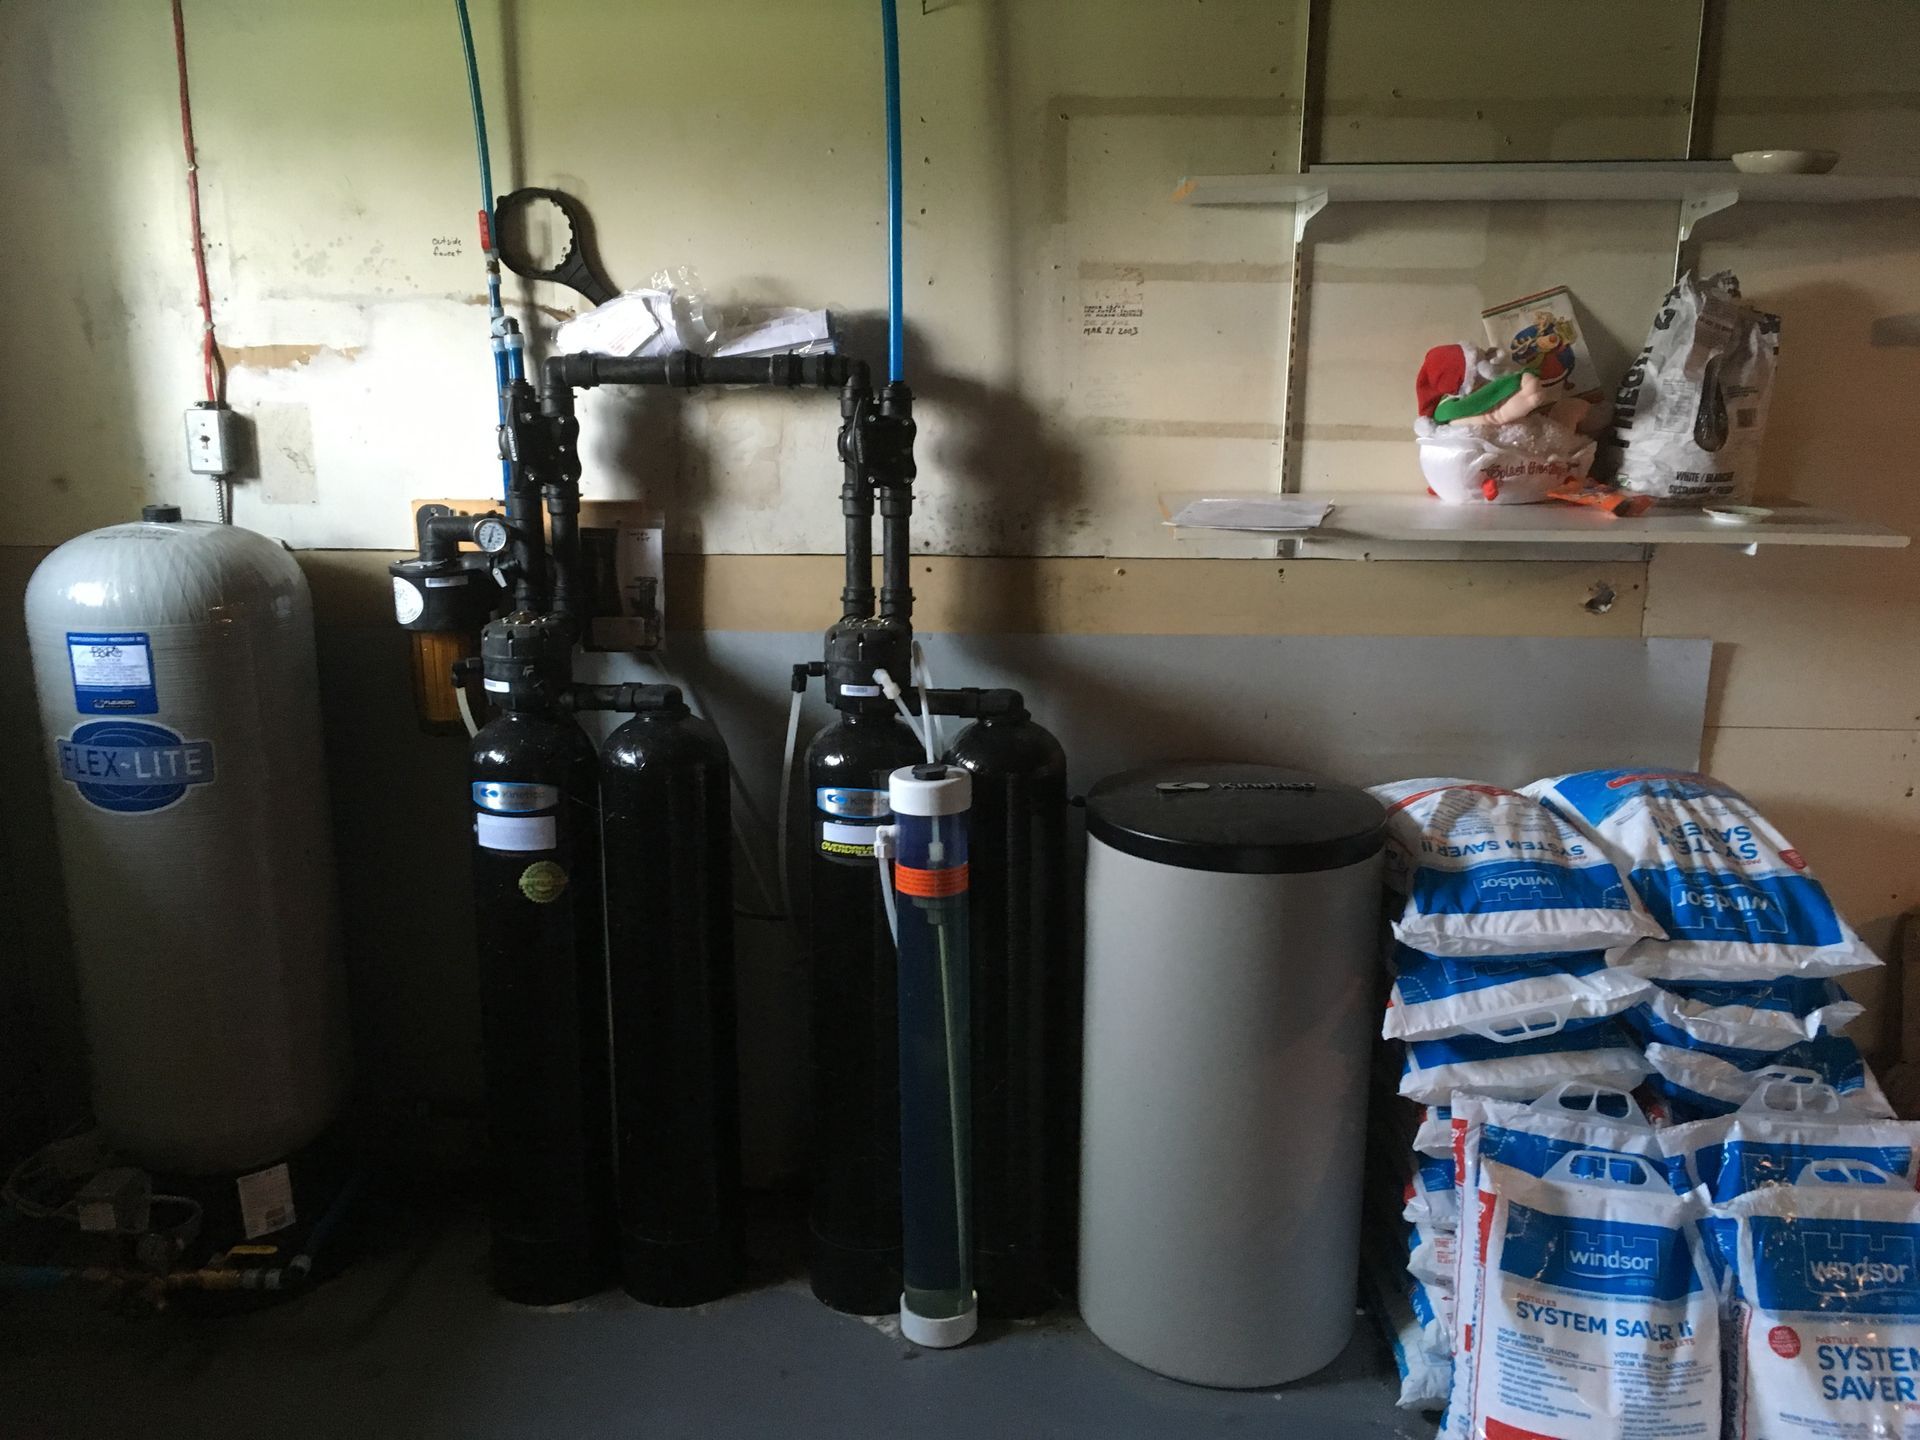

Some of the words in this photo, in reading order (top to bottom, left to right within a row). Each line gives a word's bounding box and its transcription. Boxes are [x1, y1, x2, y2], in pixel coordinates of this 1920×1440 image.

[1083, 327, 1102, 336] MAR
[1676, 471, 1700, 482] WHITE
[1438, 840, 1499, 858] SAVER
[1505, 840, 1585, 857] SYSTEM
[1479, 875, 1555, 891] windsor
[1675, 889, 1775, 917] windsor
[1569, 1247, 1653, 1271] windsor
[1810, 1256, 1911, 1284] windsor
[1516, 1301, 1607, 1336] SYSTEM
[1822, 1375, 1918, 1402] SAVER
